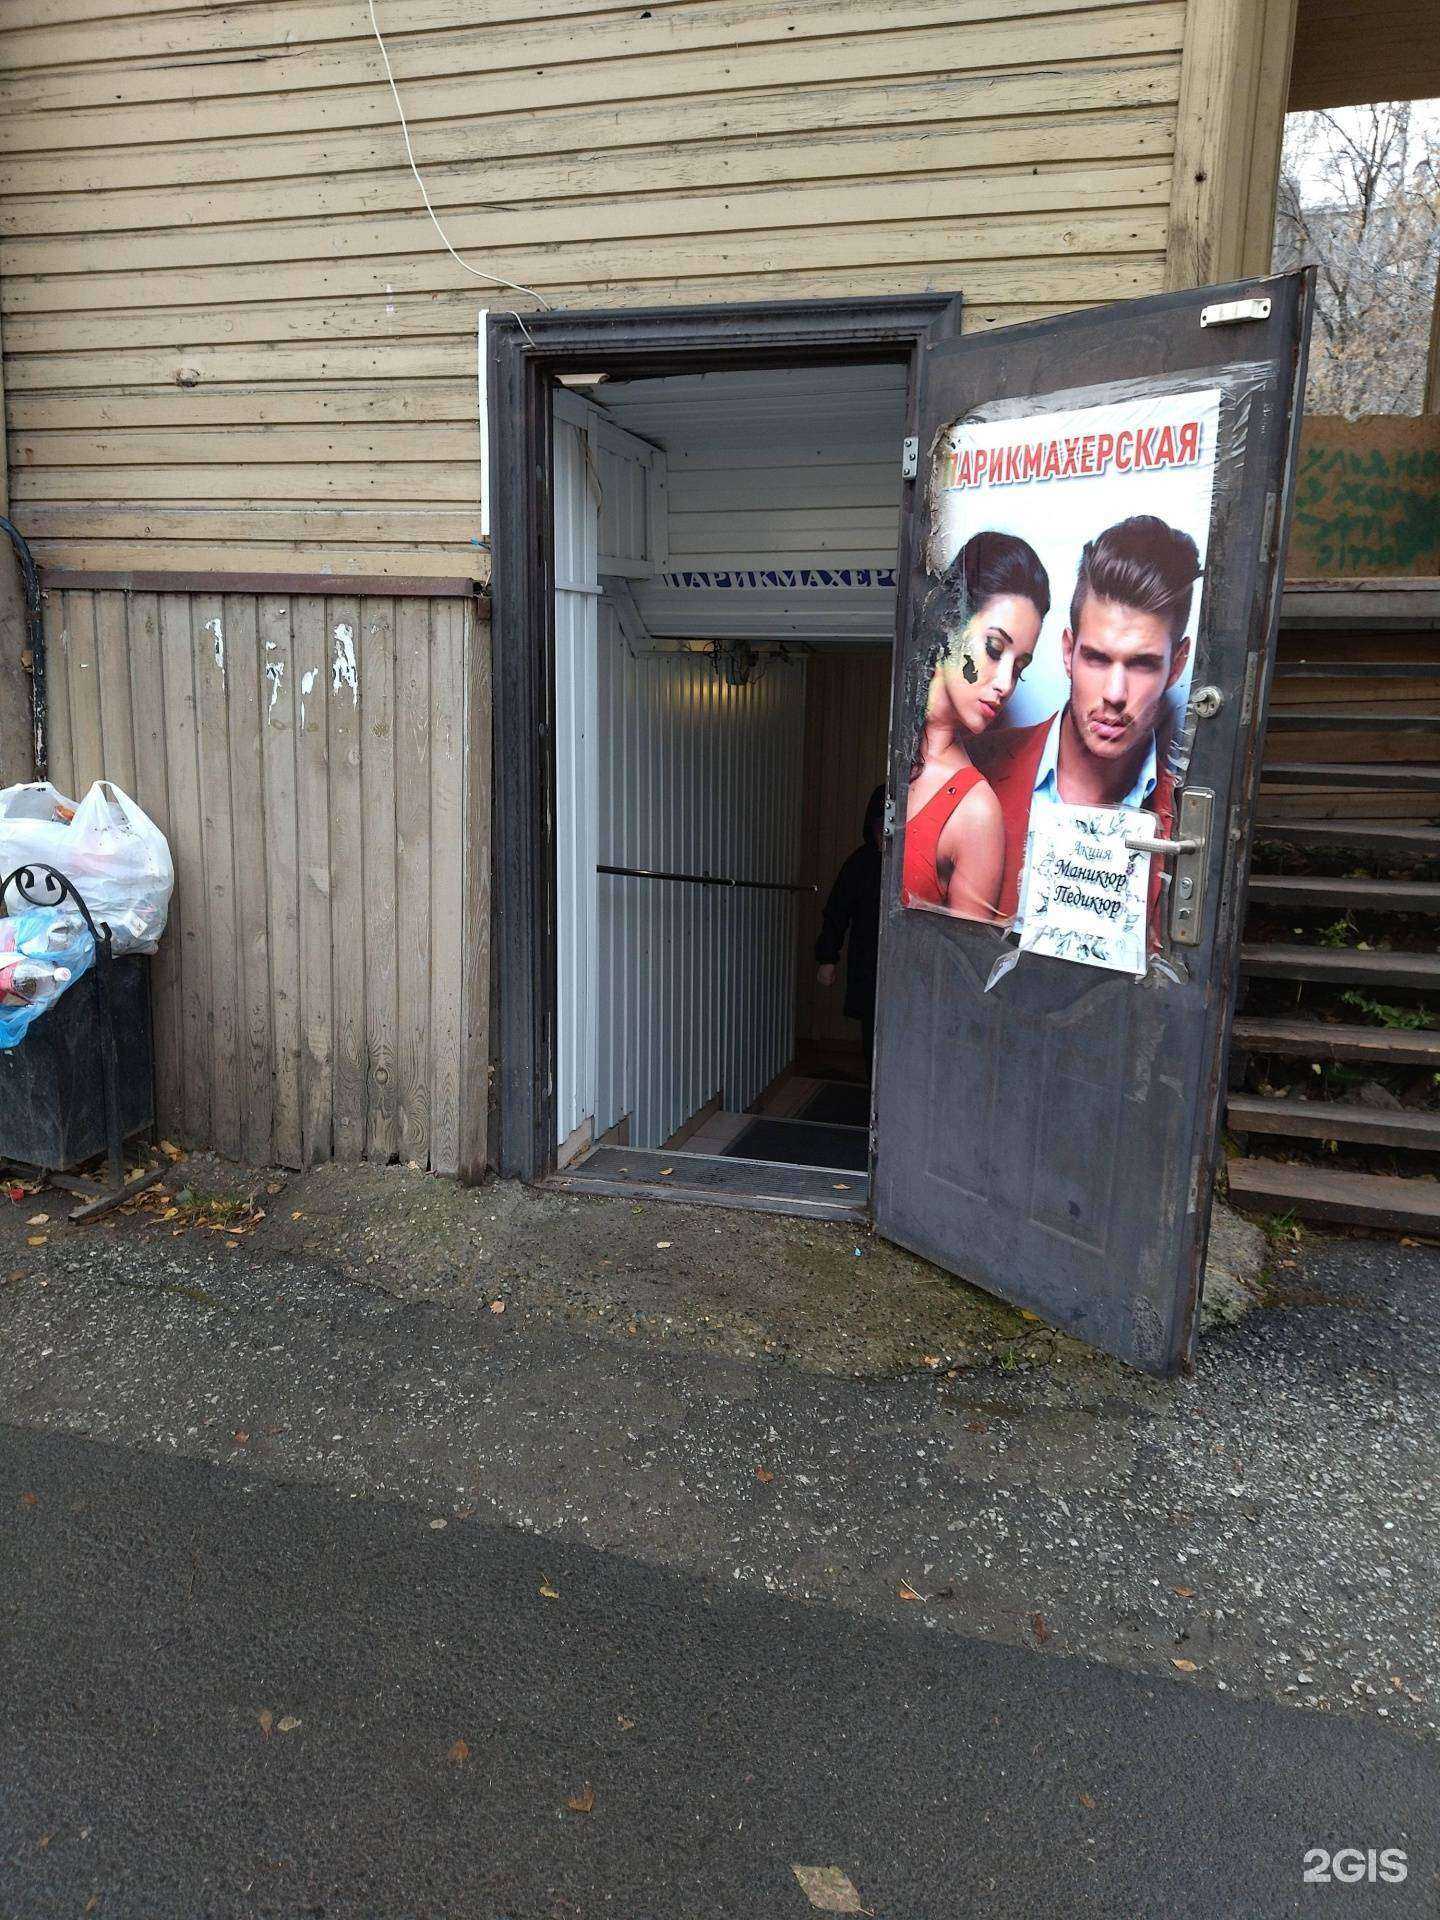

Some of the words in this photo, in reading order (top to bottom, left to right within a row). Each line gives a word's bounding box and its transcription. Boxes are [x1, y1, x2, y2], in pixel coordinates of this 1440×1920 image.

[664, 569, 898, 590] ПАРИКМАХЕР
[1054, 859, 1127, 893] Маникюр
[1053, 885, 1121, 919] Педикюр
